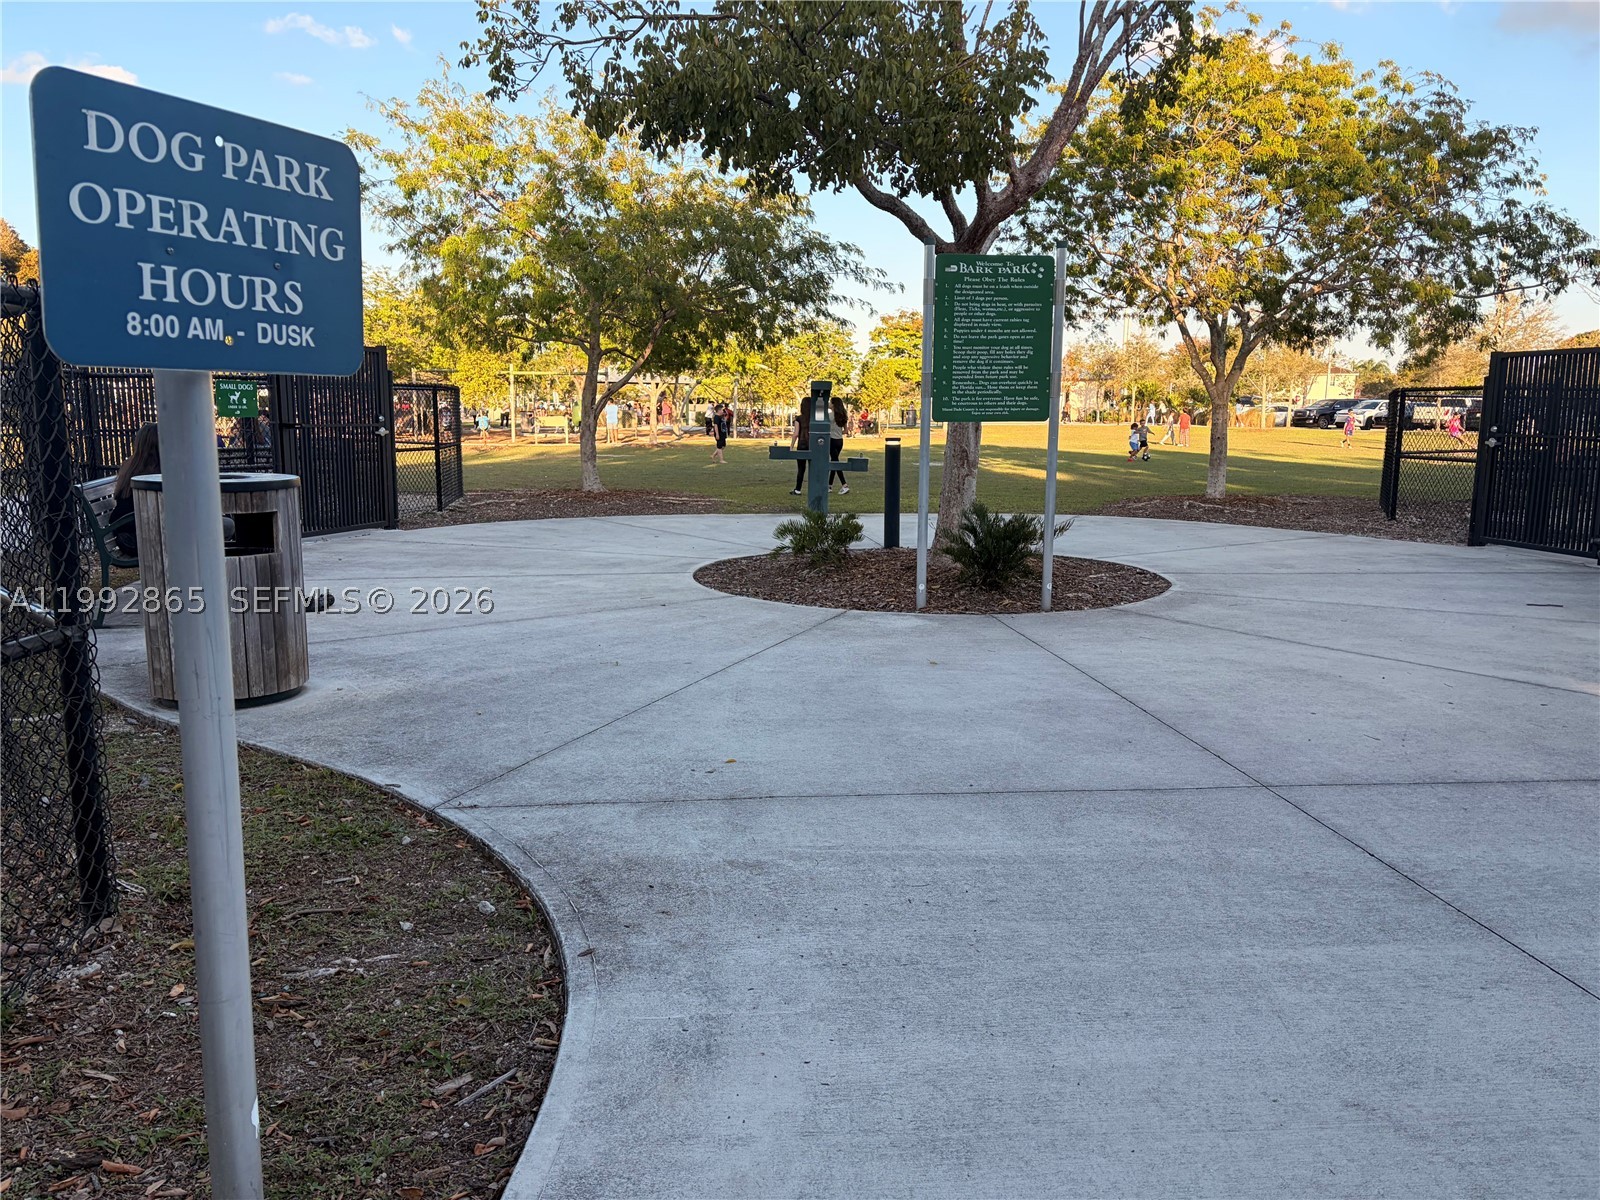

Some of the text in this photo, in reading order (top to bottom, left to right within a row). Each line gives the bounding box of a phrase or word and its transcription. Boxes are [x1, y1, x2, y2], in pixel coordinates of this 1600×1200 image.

[82, 109, 333, 201] DOG PARK
[69, 182, 346, 262] OPERATING
[137, 262, 303, 316] HOURS
[959, 262, 1031, 274] BARK PARK
[127, 312, 179, 338] 8:00
[187, 317, 224, 341] AM
[257, 322, 316, 347] DUSK
[238, 383, 254, 391] DOGS
